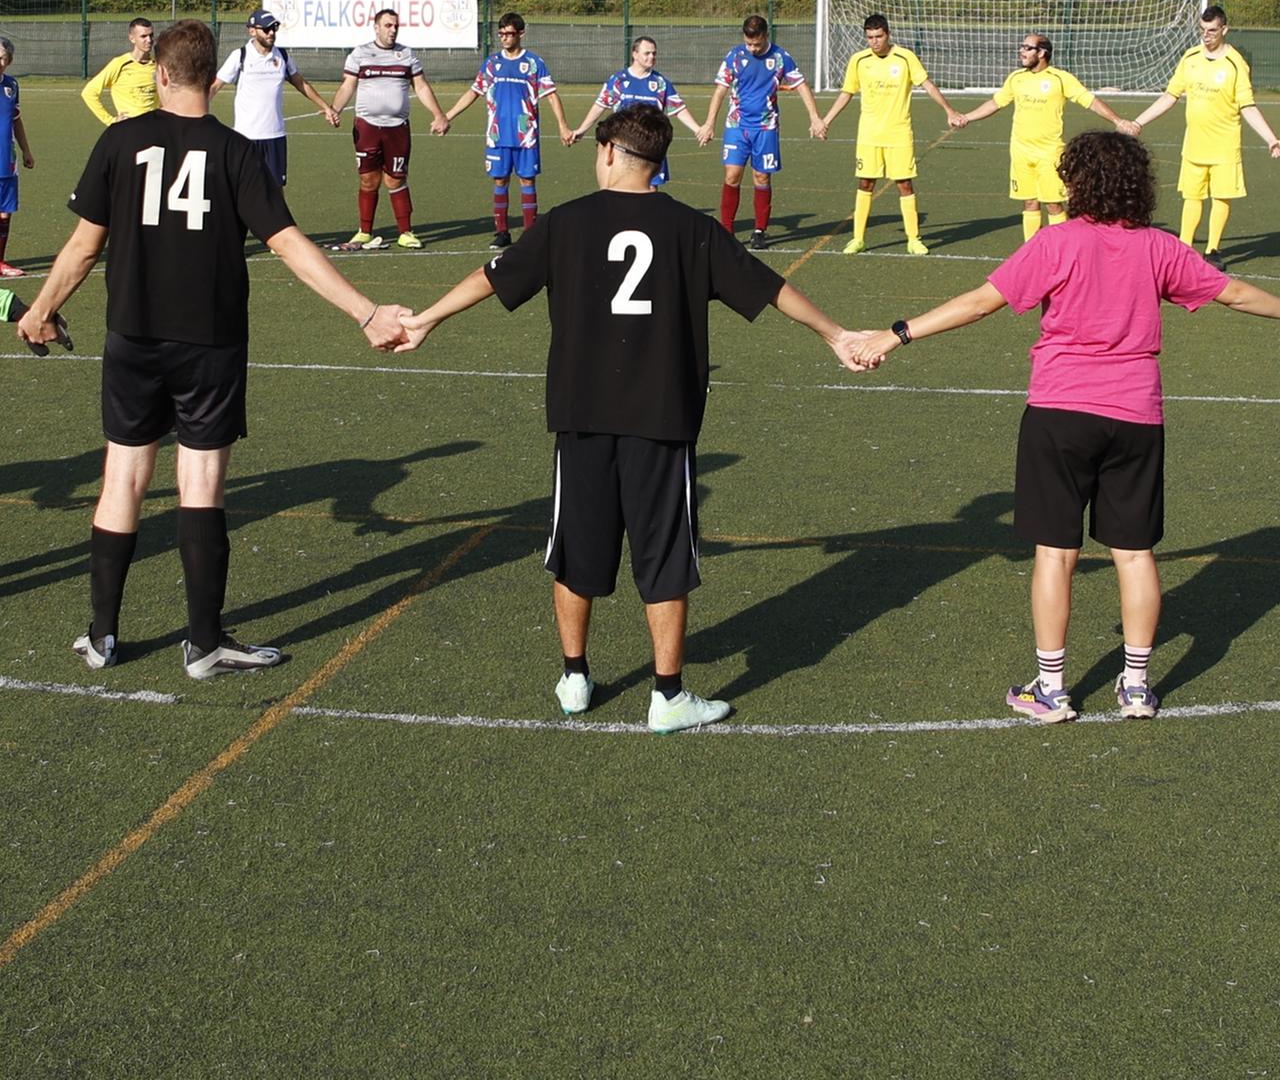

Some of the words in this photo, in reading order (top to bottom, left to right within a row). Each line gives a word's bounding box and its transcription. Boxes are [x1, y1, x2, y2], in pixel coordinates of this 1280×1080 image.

[392, 156, 405, 172] 12
[762, 153, 775, 170] 12
[136, 145, 211, 230] 14
[607, 230, 654, 315] 2
